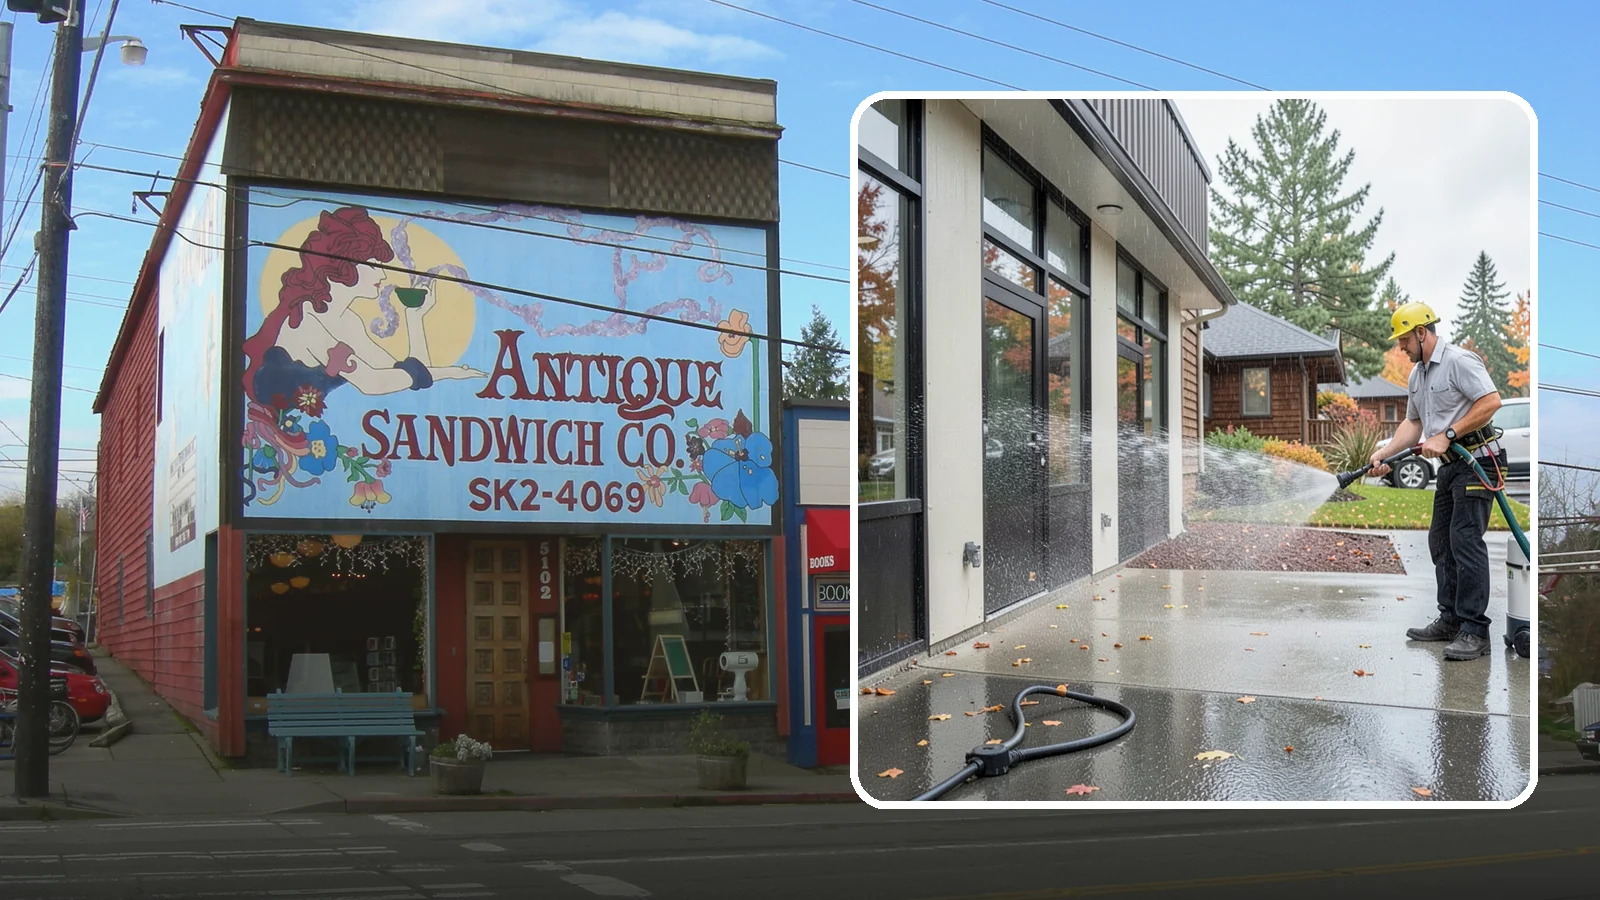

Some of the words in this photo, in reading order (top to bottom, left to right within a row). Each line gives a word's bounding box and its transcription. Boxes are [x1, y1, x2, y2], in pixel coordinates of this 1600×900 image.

[476, 330, 723, 420] ANTIQUE
[361, 409, 604, 467] SANDWICH
[617, 421, 685, 468] CO.
[468, 478, 645, 513] SK2-4069
[539, 541, 552, 599] 5102
[809, 555, 834, 568] BOOKS
